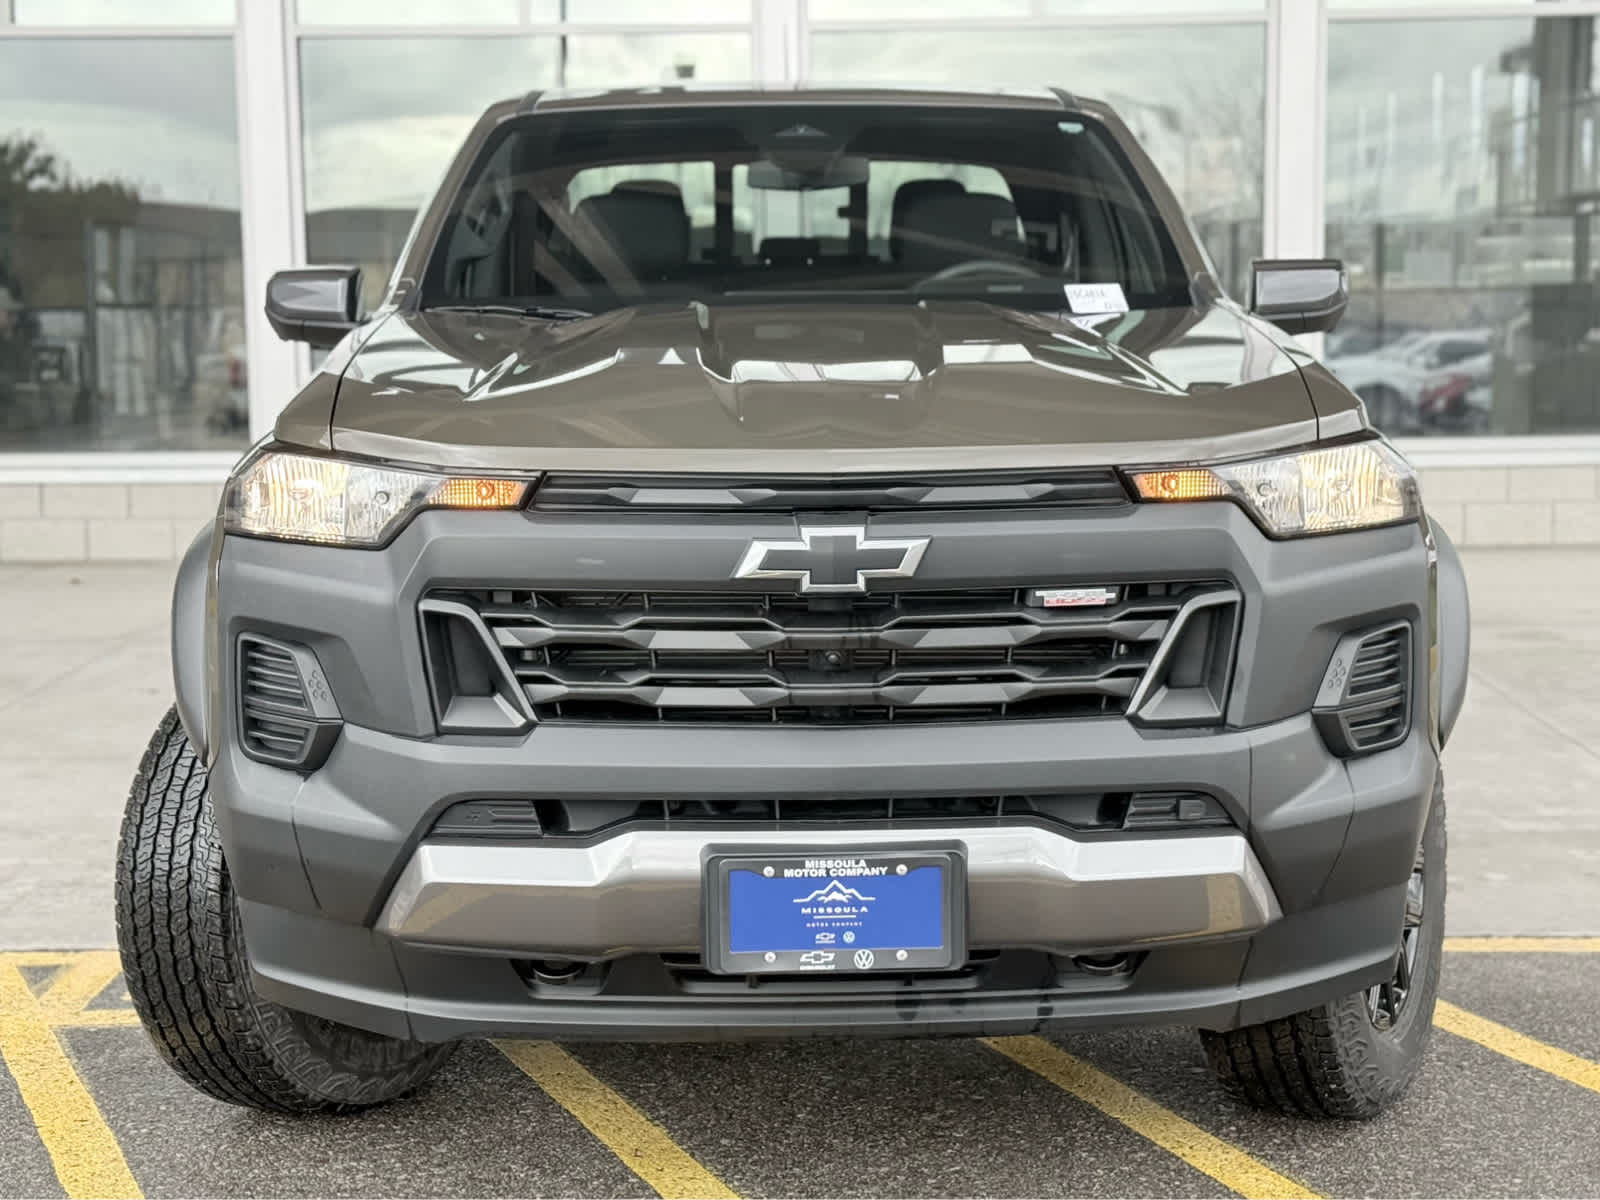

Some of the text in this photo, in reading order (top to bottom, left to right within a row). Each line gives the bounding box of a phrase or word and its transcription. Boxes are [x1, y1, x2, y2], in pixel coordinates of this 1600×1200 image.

[805, 859, 867, 869] MISSOULA
[783, 866, 888, 878] MOTOR COMPANY
[801, 906, 868, 914] MISSOULA
